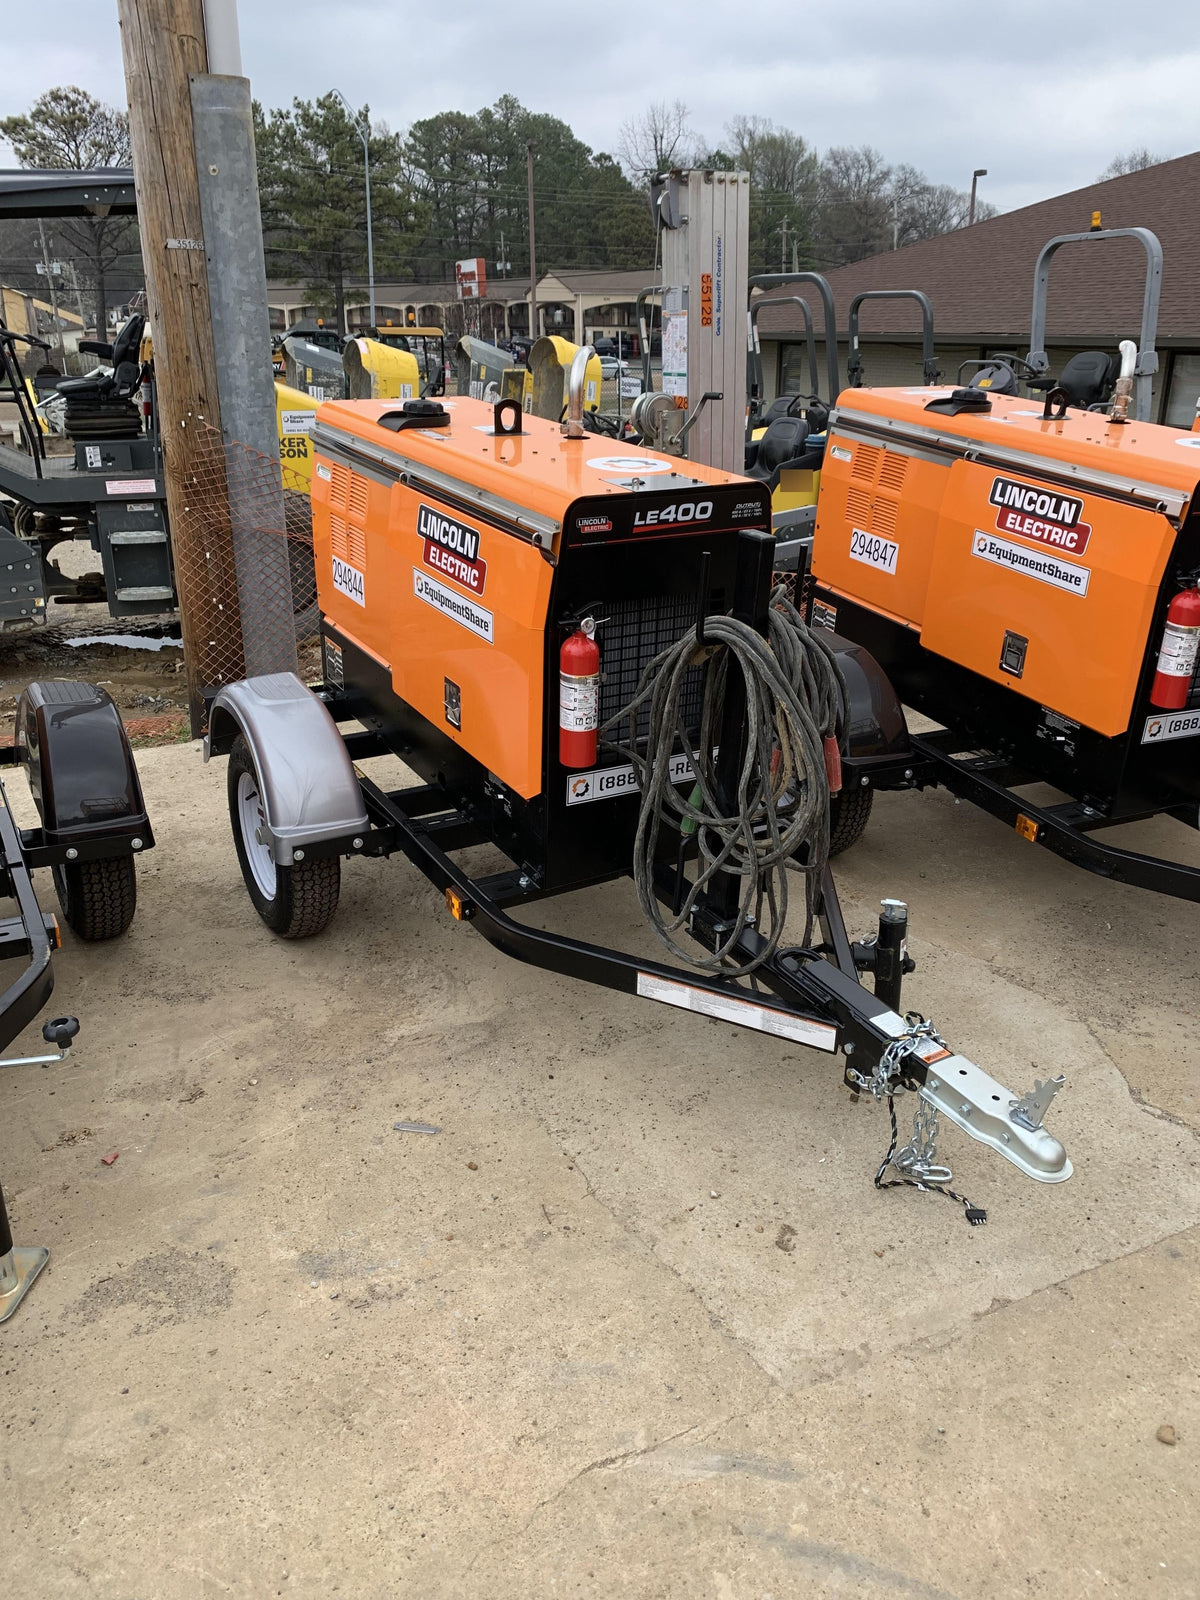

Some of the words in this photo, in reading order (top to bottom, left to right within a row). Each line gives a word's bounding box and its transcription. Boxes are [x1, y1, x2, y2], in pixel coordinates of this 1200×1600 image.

[176, 239, 205, 250] 35126
[701, 274, 712, 326] 55128
[279, 437, 307, 447] KER
[279, 448, 308, 458] SON
[634, 501, 714, 525] LE400
[993, 482, 1077, 524] LINCOLN
[419, 510, 476, 559] LINCOLN
[578, 517, 607, 526] LINCOLN
[1005, 512, 1079, 548] ELECTRIC
[429, 545, 479, 587] ELECTRIC
[851, 531, 897, 567] 294847
[988, 541, 1082, 587] EquipmentShare
[332, 558, 363, 600] 294844
[424, 581, 489, 632] EquipmentShare
[1168, 717, 1200, 733] (888
